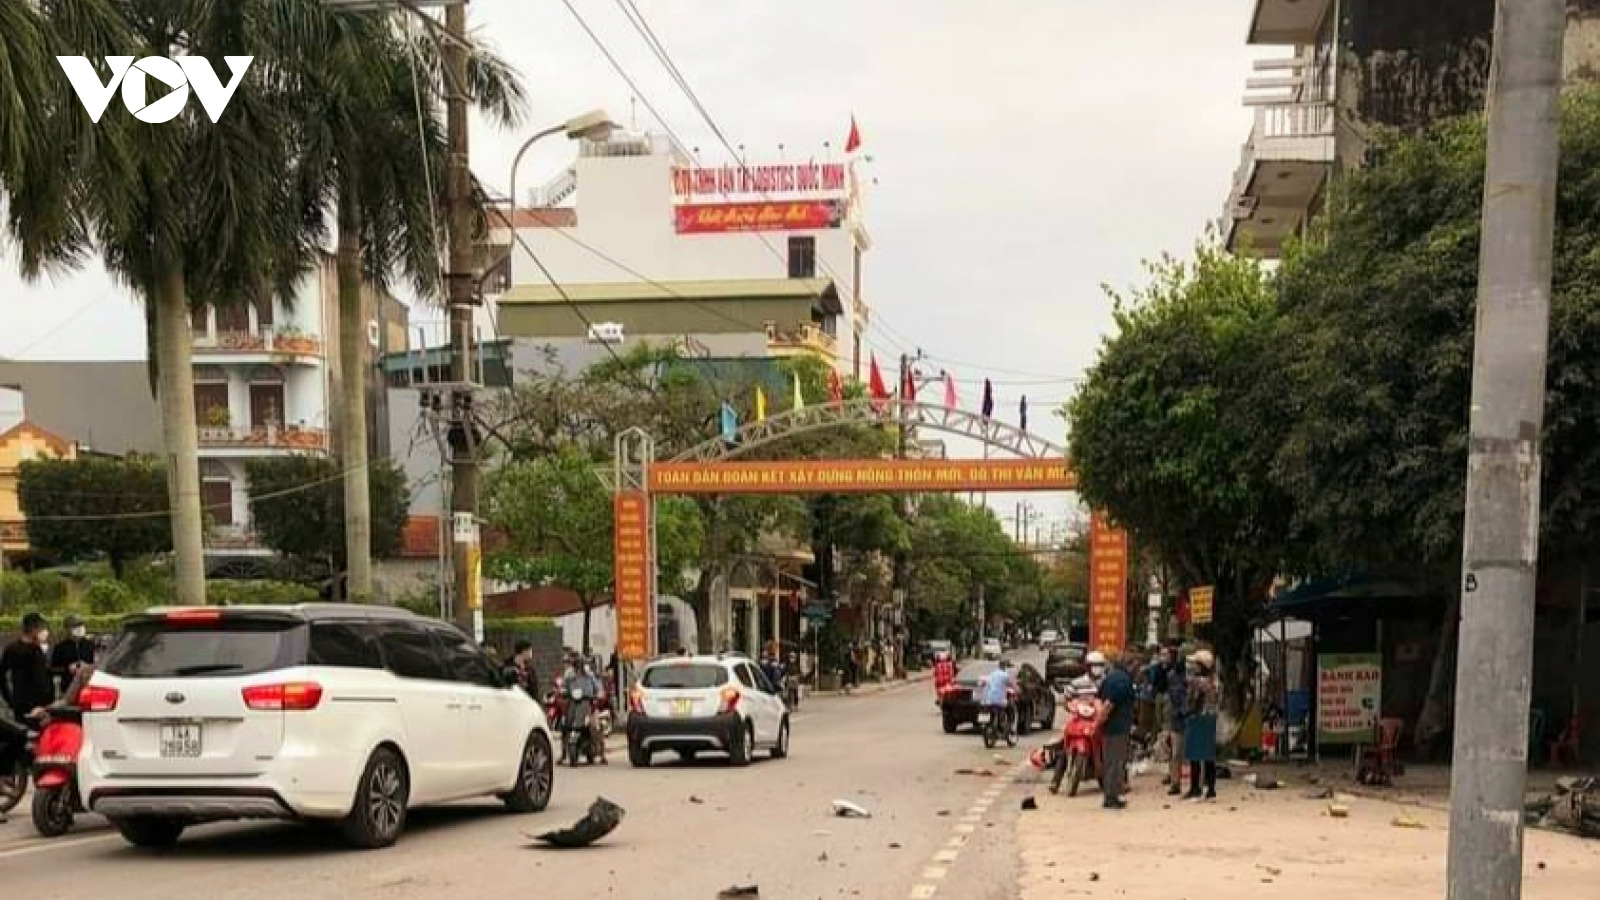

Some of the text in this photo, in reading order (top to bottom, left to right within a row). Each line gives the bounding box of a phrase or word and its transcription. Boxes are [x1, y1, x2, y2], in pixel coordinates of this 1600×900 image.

[821, 164, 844, 190] MINH
[694, 466, 719, 484] DÂN
[762, 466, 784, 483] KẾT
[790, 465, 814, 483] XÂY
[856, 465, 893, 483] NÔNG
[899, 465, 932, 483] THÔN
